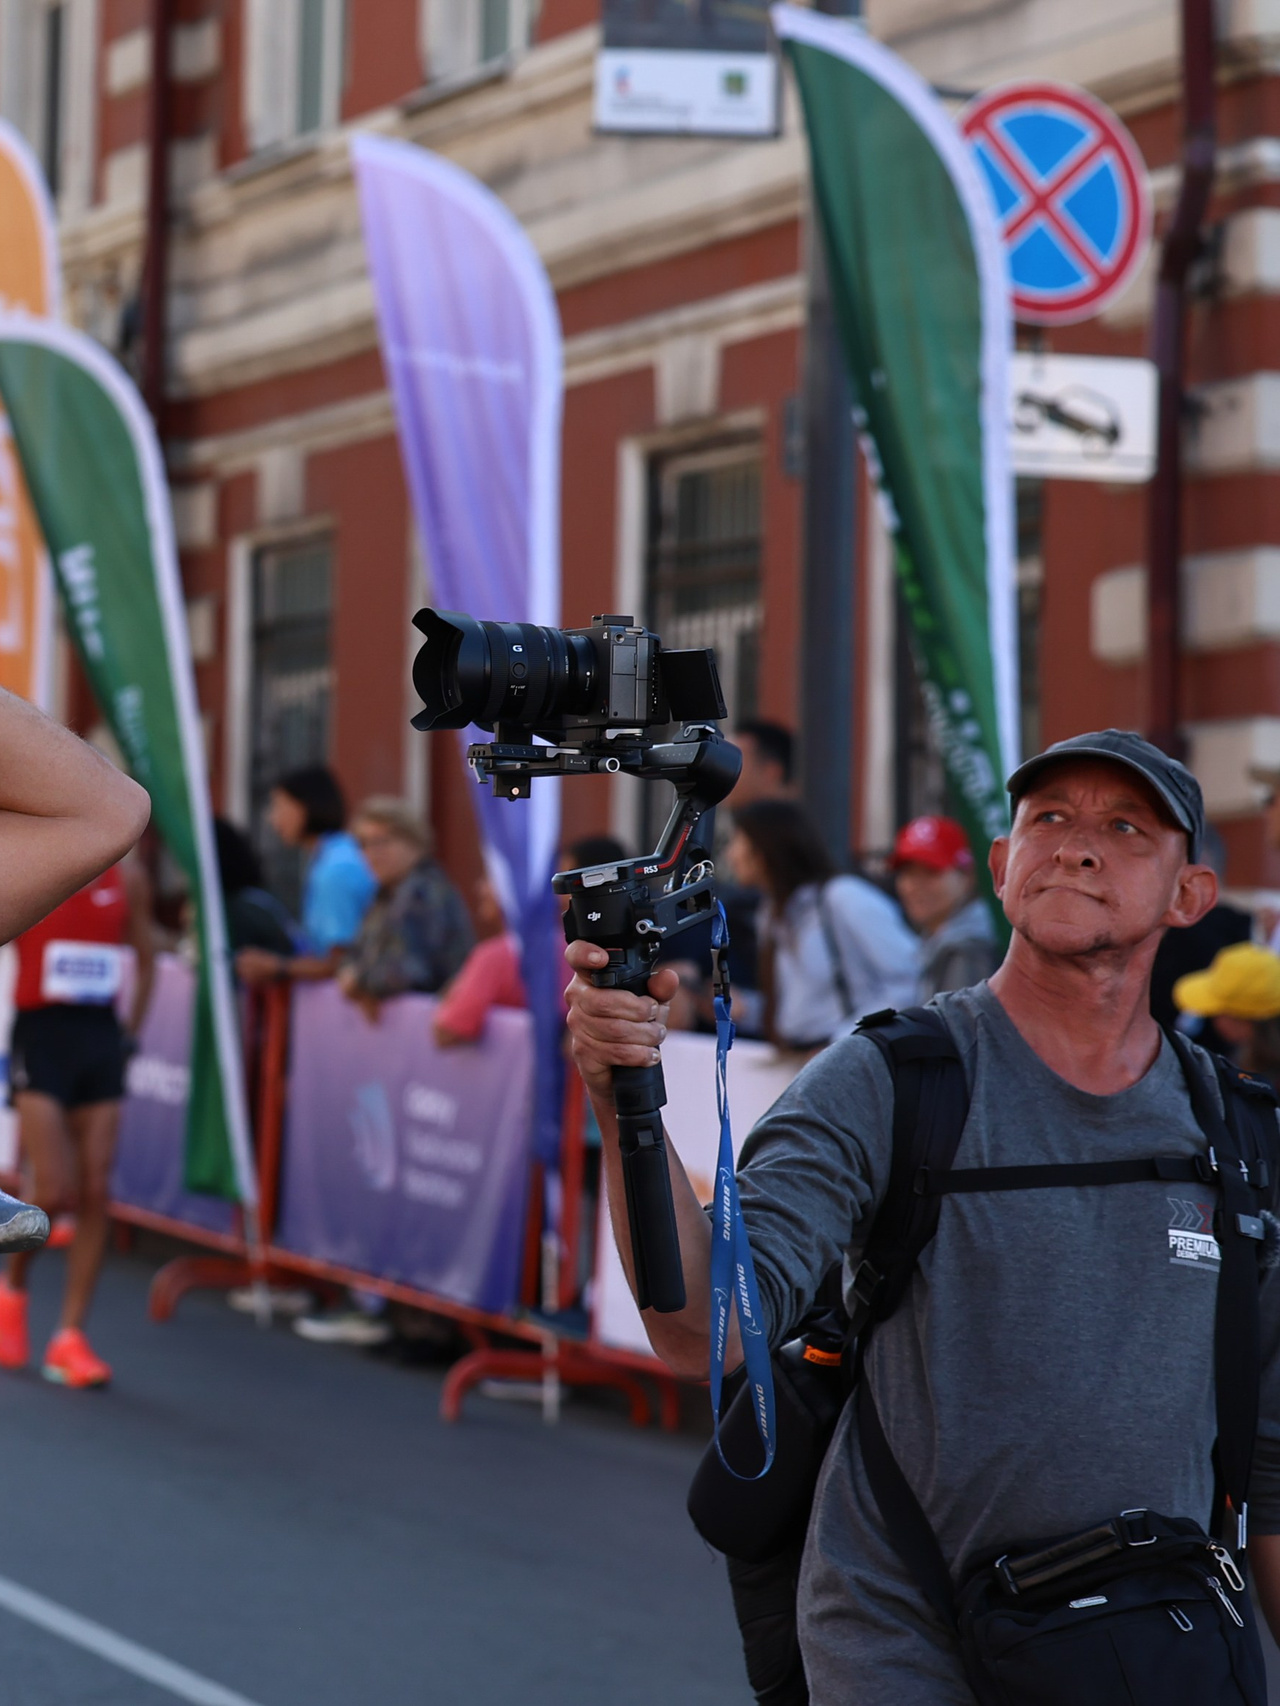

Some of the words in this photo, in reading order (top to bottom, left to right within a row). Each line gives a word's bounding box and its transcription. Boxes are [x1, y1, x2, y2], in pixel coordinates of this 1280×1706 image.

[722, 1185, 731, 1241] BOEING
[736, 1263, 752, 1319] BOEING
[716, 1305, 726, 1362] BOEING
